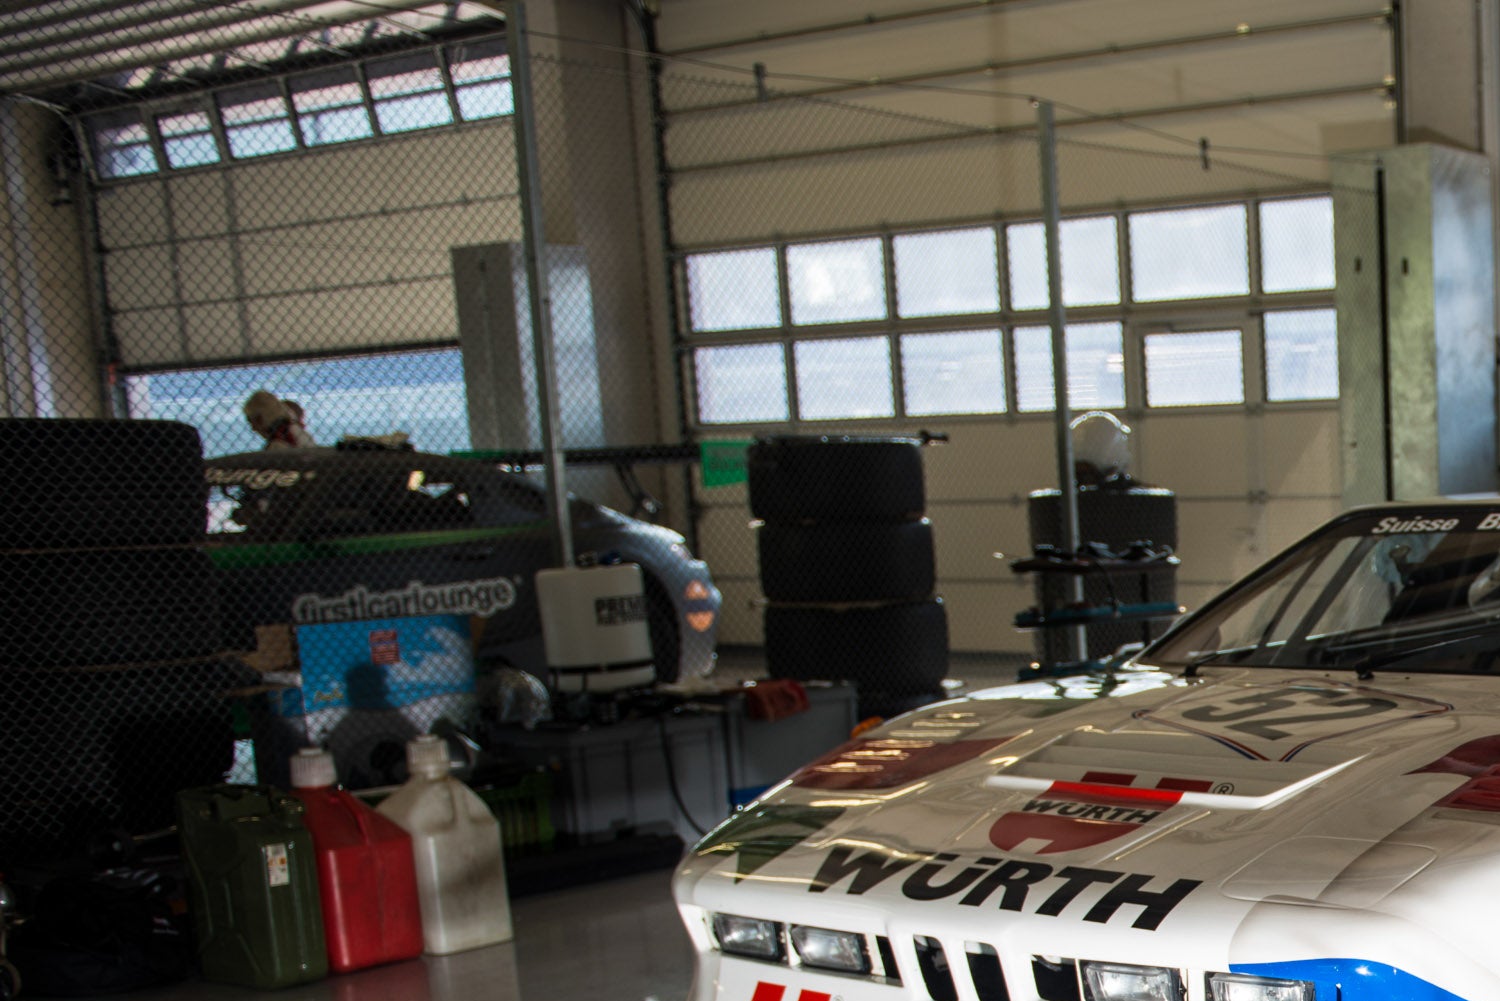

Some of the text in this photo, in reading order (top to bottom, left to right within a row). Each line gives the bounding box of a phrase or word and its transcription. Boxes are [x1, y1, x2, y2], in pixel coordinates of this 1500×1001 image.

[1371, 516, 1459, 534] Suisse
[1181, 687, 1398, 741] 52
[1021, 799, 1163, 824] WÜRTH
[807, 846, 1204, 932] WÜRTH
